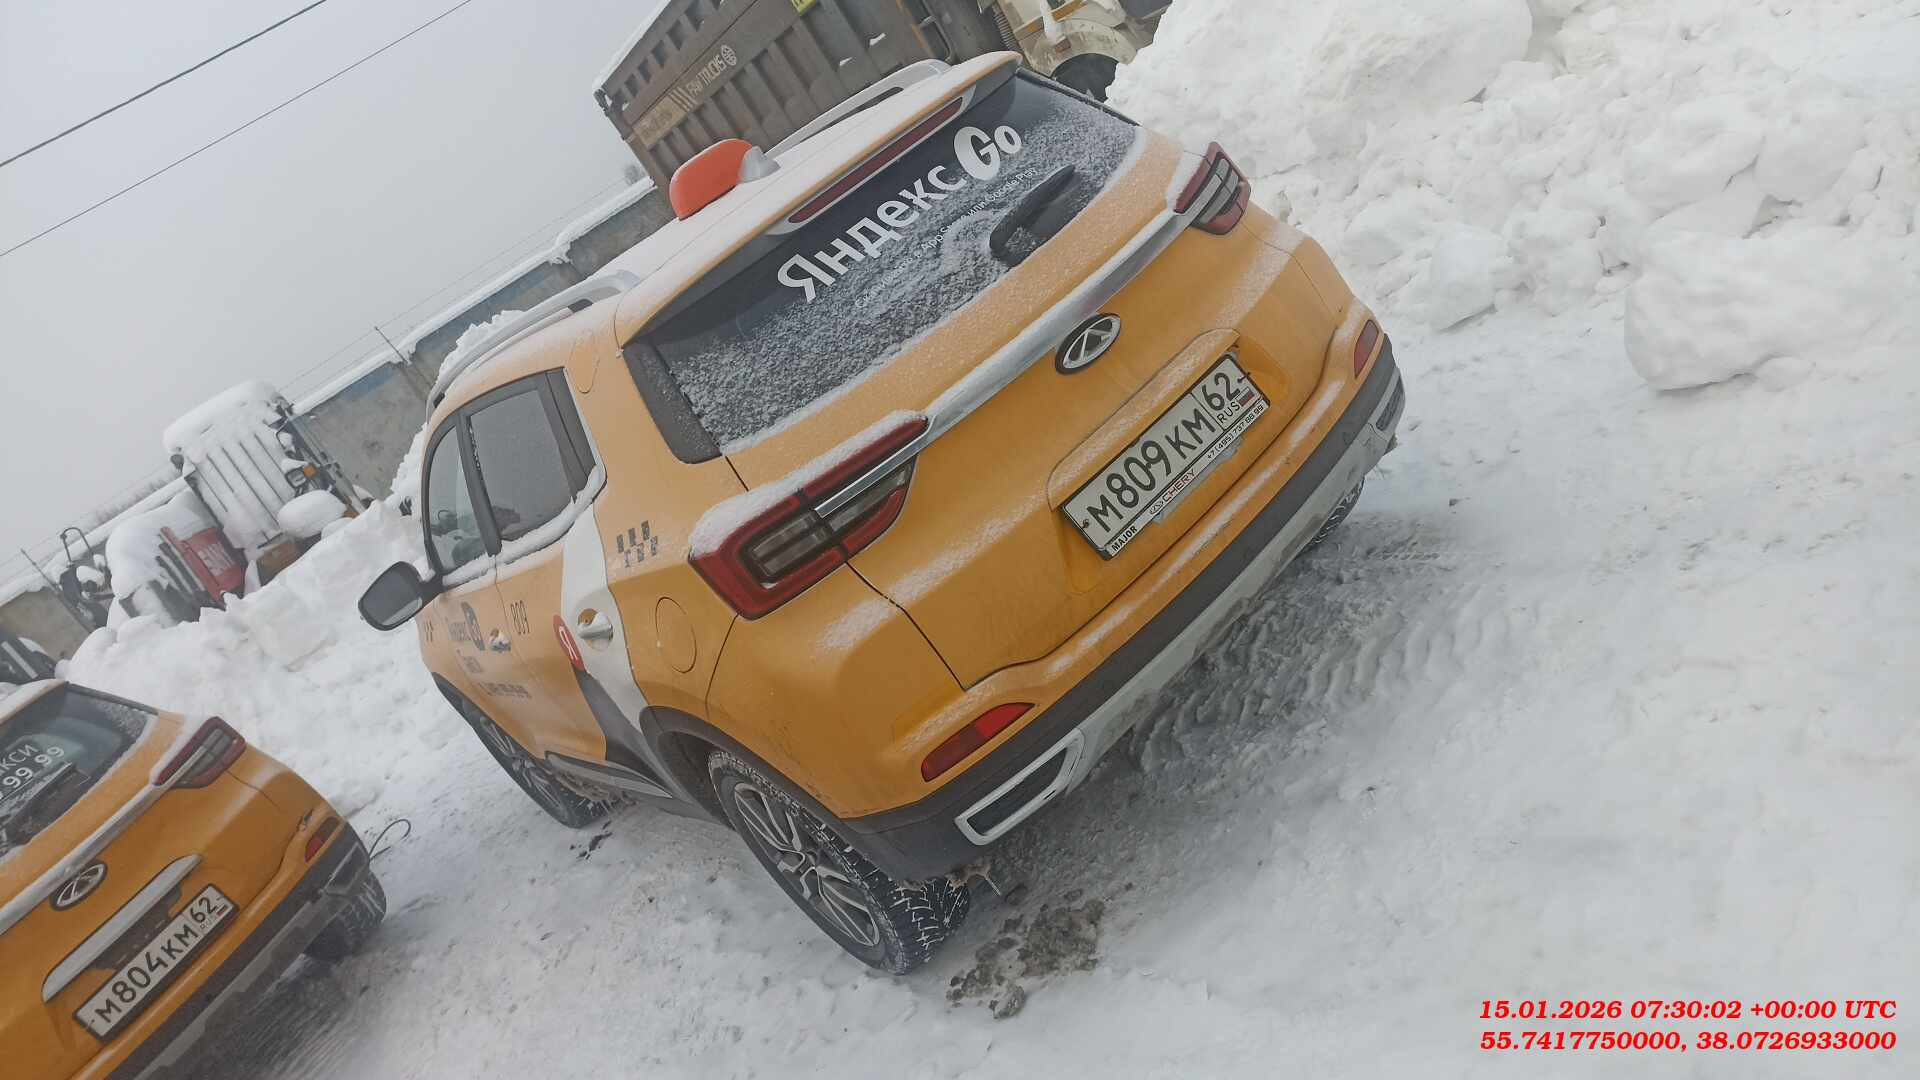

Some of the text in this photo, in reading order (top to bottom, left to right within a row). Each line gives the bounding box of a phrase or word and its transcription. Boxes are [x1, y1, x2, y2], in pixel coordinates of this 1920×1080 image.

[777, 125, 1023, 304] Яндекс Go
[1202, 372, 1241, 411] 62
[1216, 401, 1241, 424] RUS
[1162, 468, 1198, 503] CHERY
[1111, 525, 1138, 552] MAJOR
[0, 744, 38, 776] КСИ
[190, 897, 218, 923] 62
